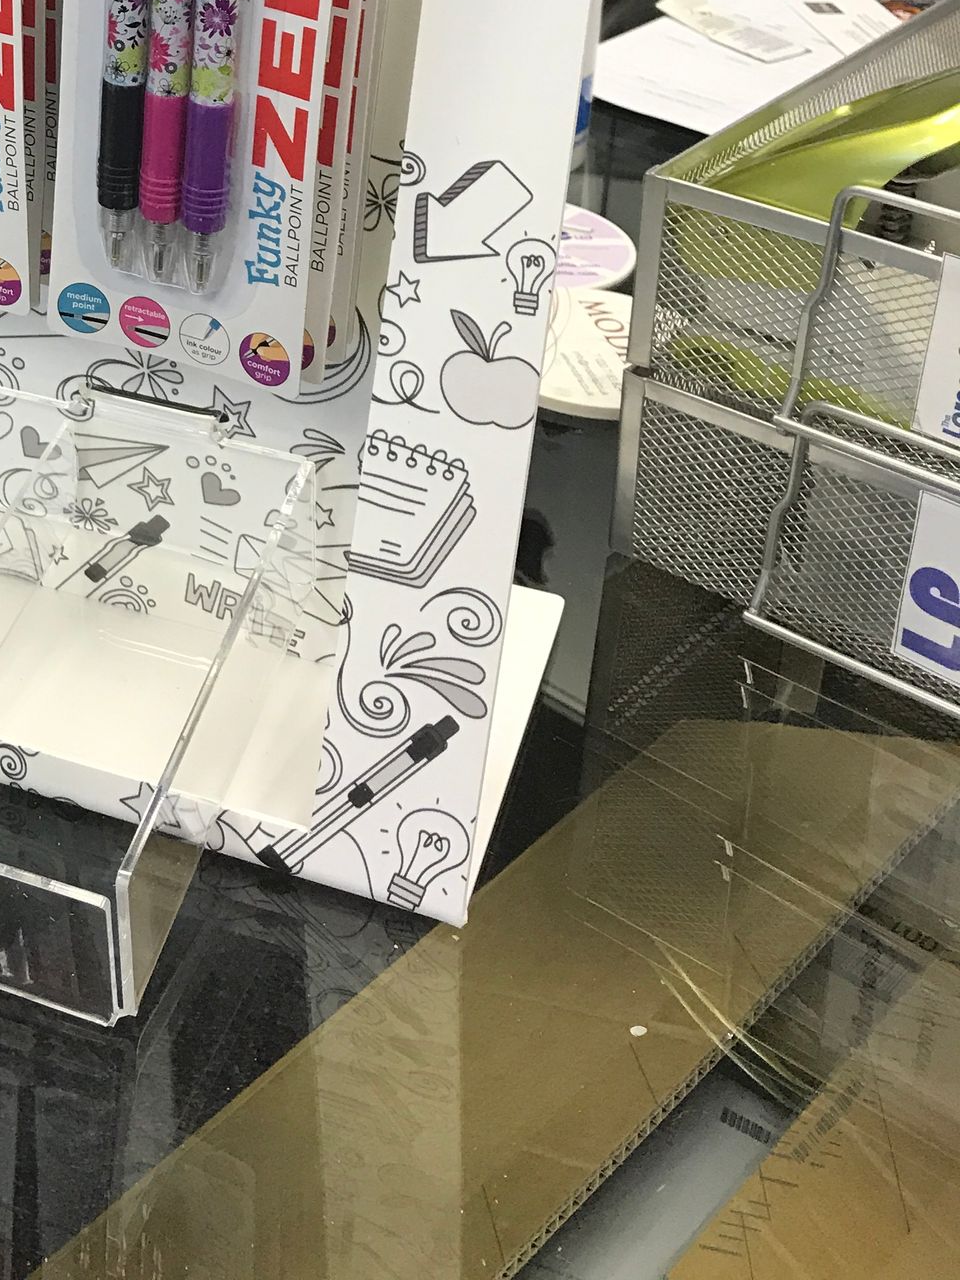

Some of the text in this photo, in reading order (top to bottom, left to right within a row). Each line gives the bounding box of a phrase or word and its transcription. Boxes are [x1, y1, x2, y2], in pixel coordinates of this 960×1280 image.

[3, 114, 20, 212] BALLPOINT
[23, 105, 37, 202] BALLPOINT
[244, 171, 287, 287] Funky
[310, 169, 333, 273] BALLPOINT
[284, 183, 304, 288] BALLPOINT
[66, 290, 103, 305] medium
[72, 300, 96, 312] point
[124, 302, 167, 321] retractable
[186, 339, 222, 357] ink colour
[191, 349, 217, 362] as grip
[246, 359, 281, 378] comfort
[254, 370, 272, 383] grip
